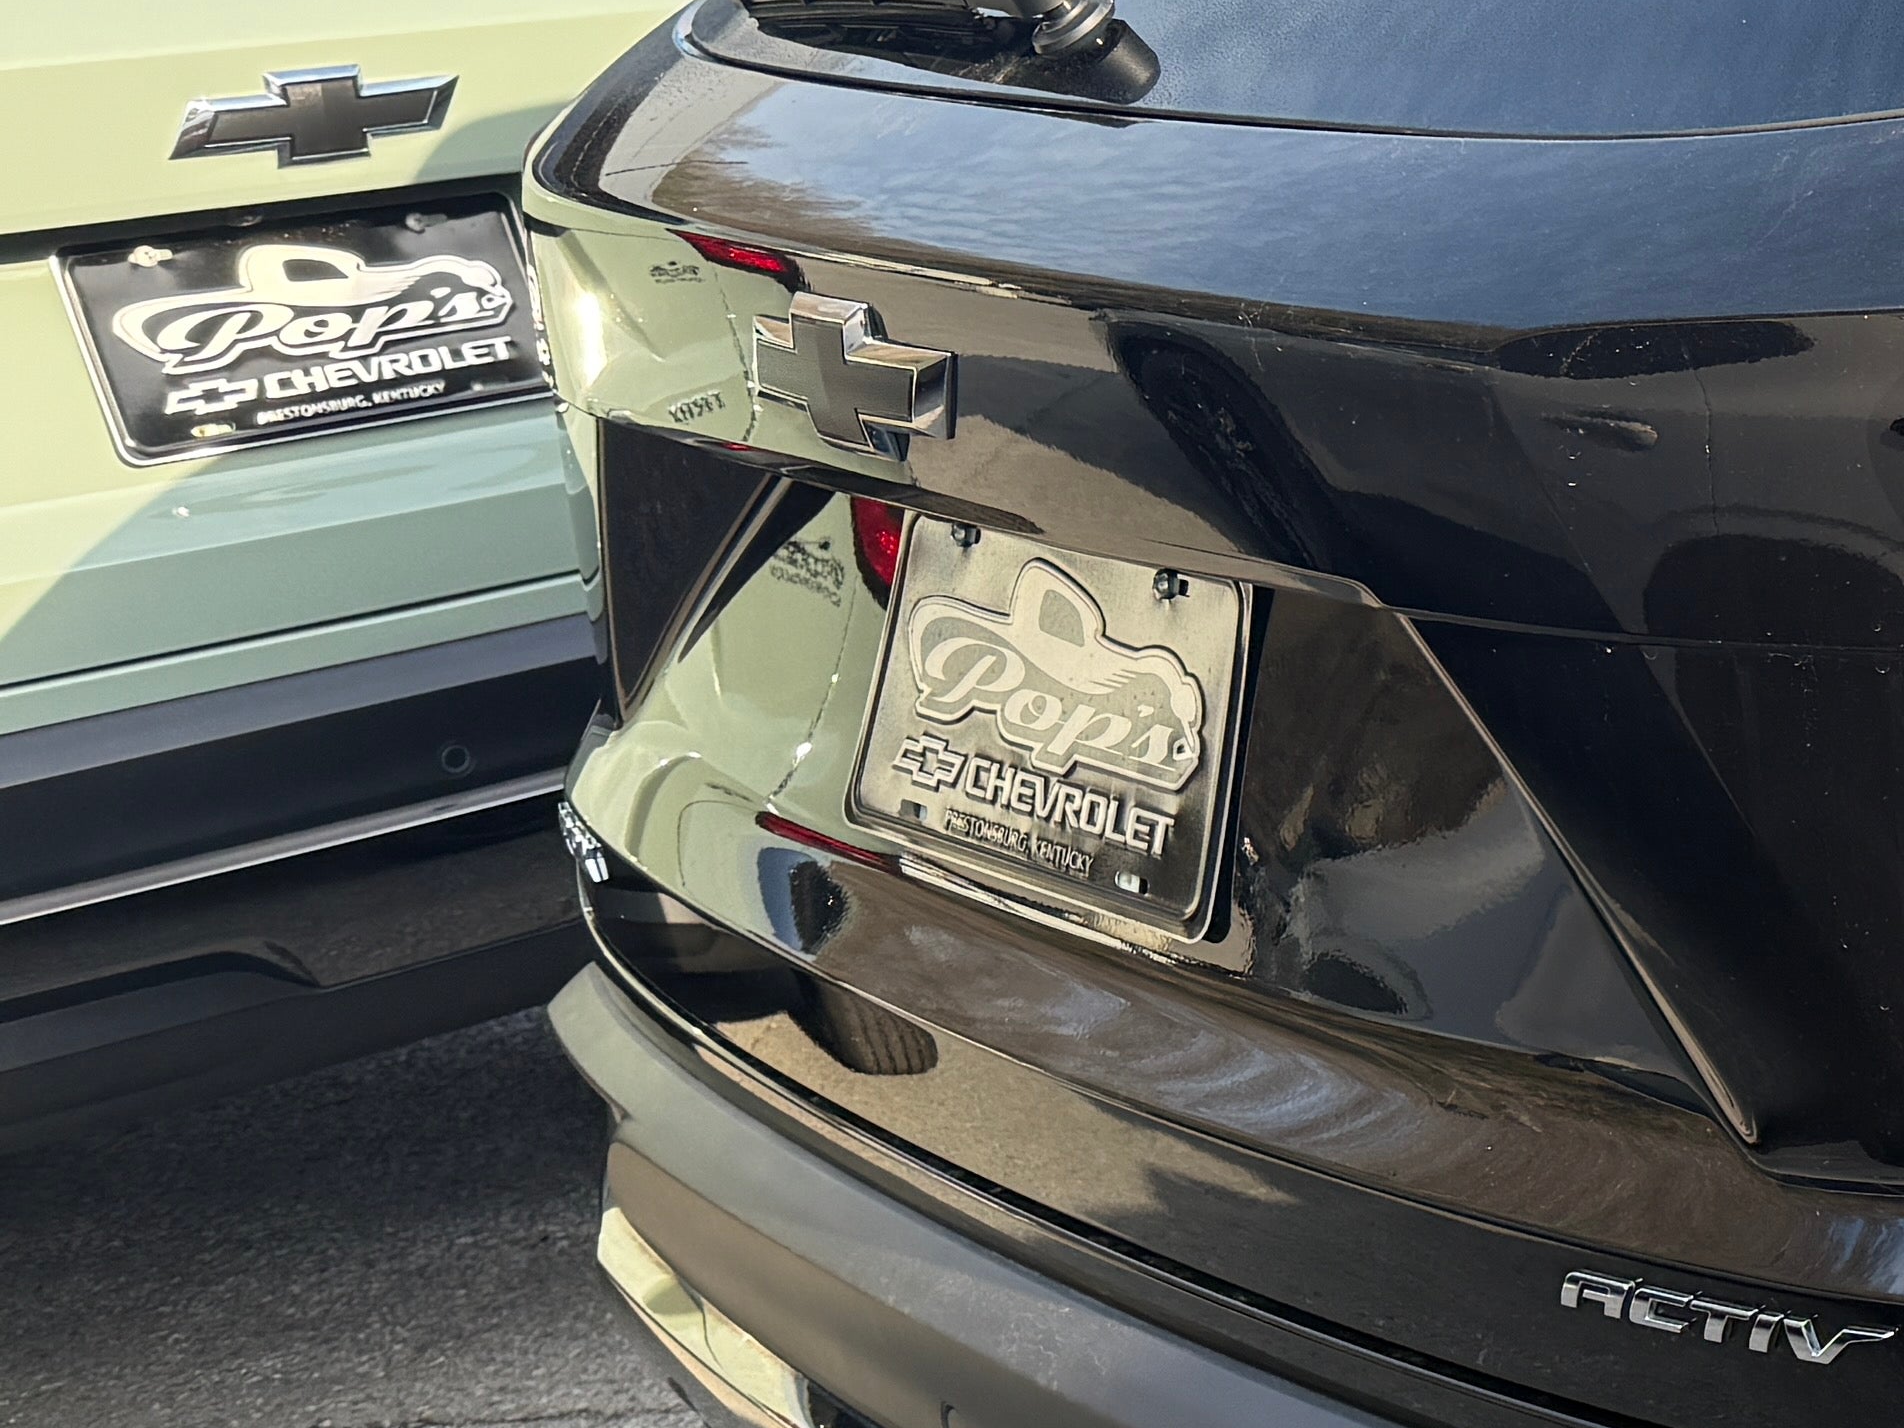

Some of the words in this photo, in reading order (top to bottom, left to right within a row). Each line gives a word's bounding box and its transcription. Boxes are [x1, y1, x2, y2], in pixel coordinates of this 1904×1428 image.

[158, 286, 498, 360] Pop's
[264, 336, 511, 400] CHEVROLET
[373, 382, 446, 405] KENTUCKY
[924, 636, 1177, 772] Pop's
[964, 756, 1175, 857] CHEVROLET
[1031, 836, 1094, 875] KENTUCKY
[1560, 1270, 1898, 1365] ACTIV
